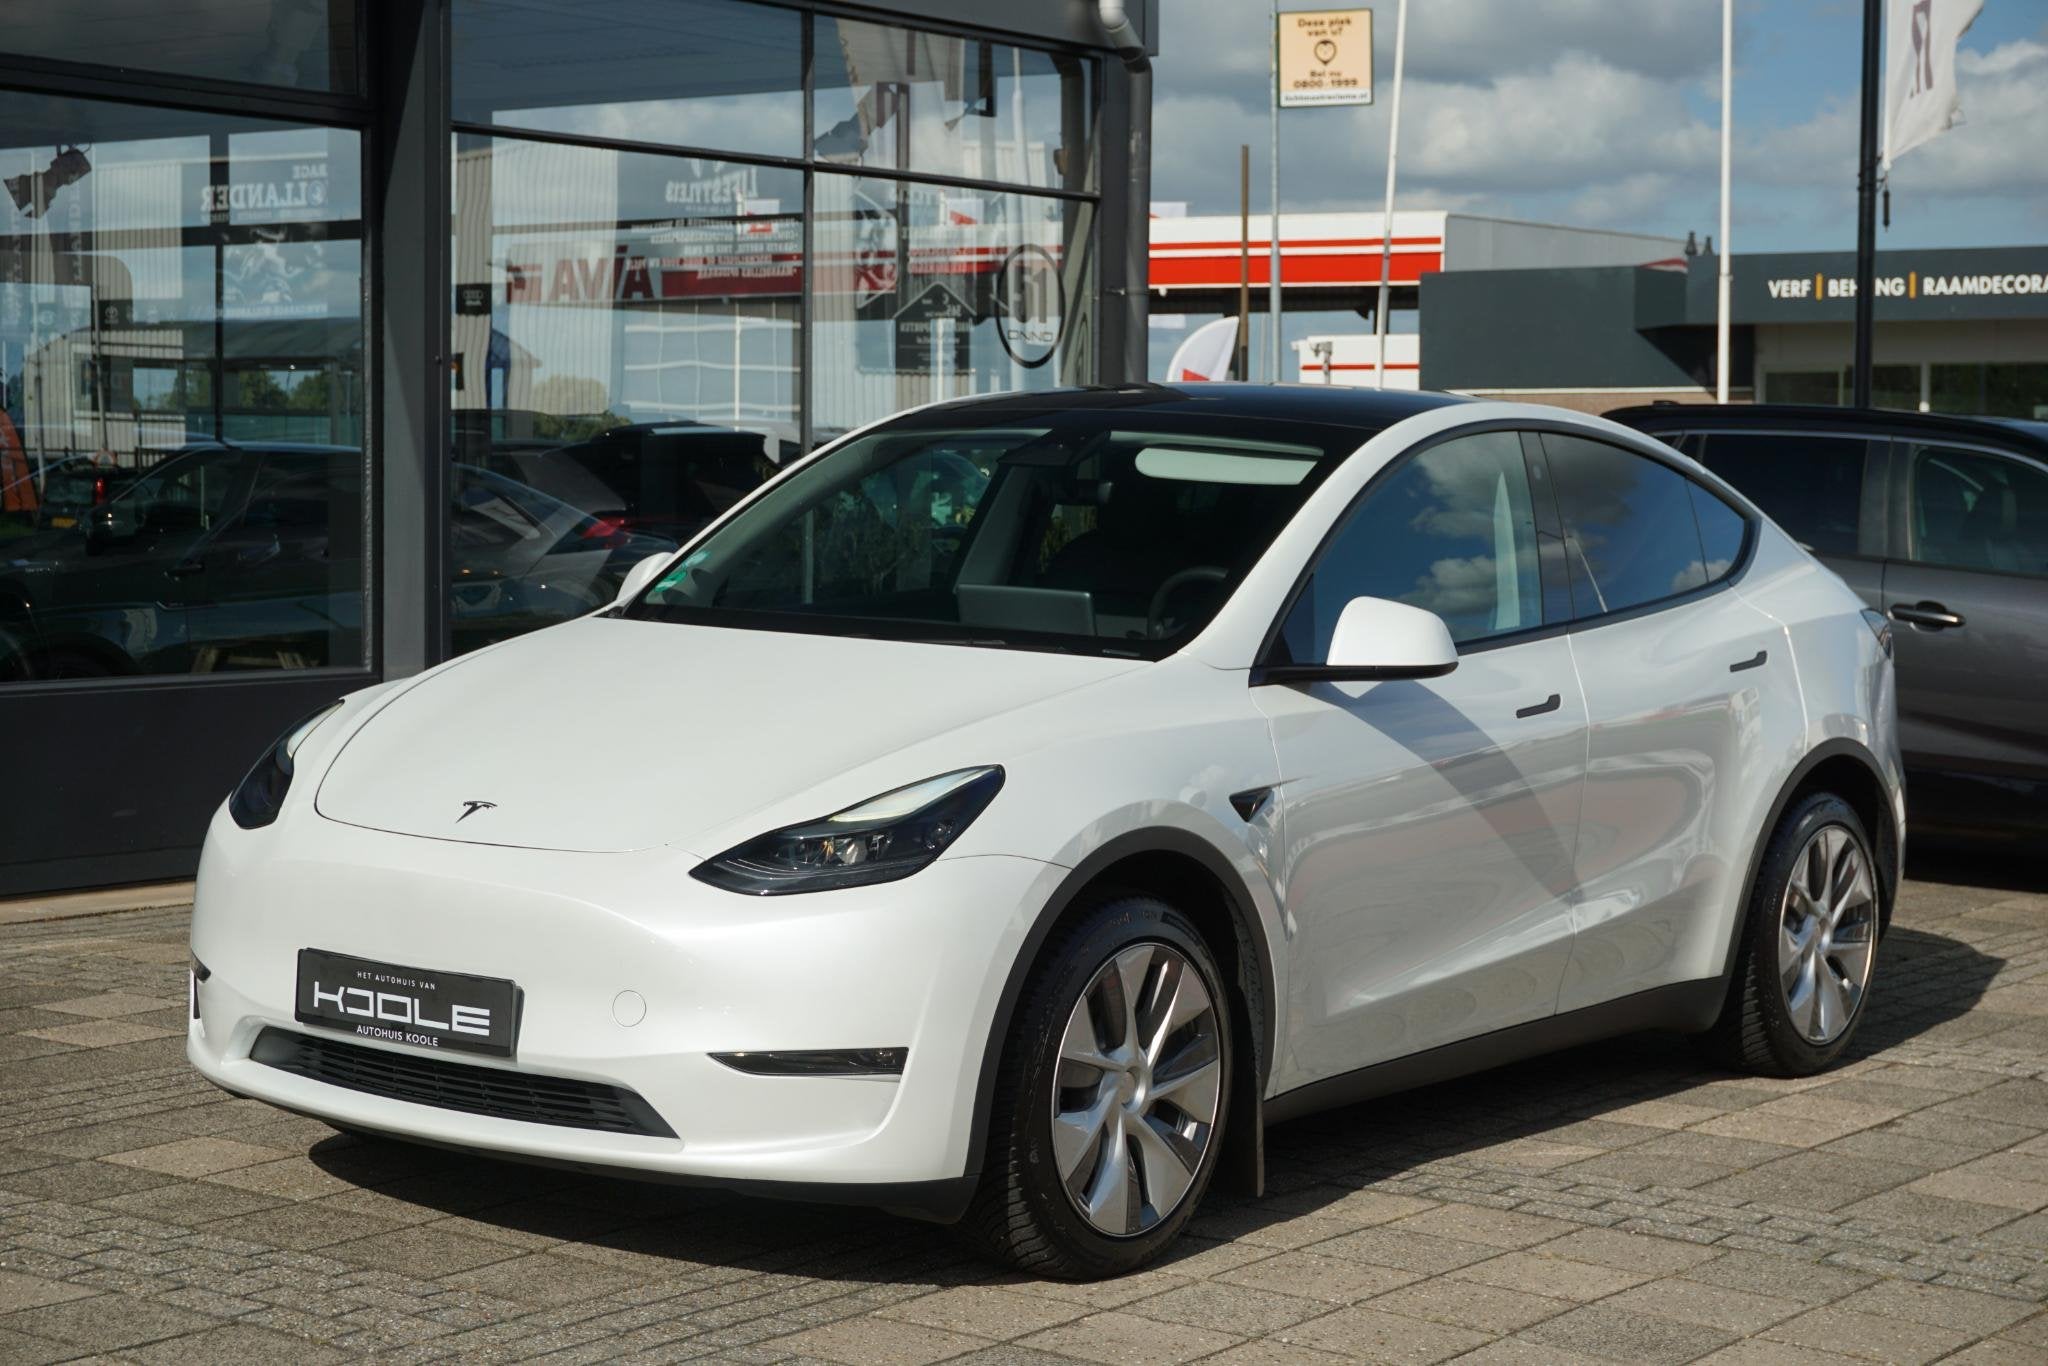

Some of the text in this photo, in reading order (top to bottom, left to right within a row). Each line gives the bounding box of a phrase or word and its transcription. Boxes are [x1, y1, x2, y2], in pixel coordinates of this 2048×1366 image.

[1307, 27, 1343, 37] van u?
[1329, 16, 1352, 27] plek
[1768, 279, 1812, 299] VERF
[1827, 276, 1906, 298] BEHNG
[356, 970, 436, 990] HET AUTOHUIS VAN
[313, 980, 491, 1037] KOOLE
[356, 1024, 439, 1047] AUTOHUIS KOOLE
